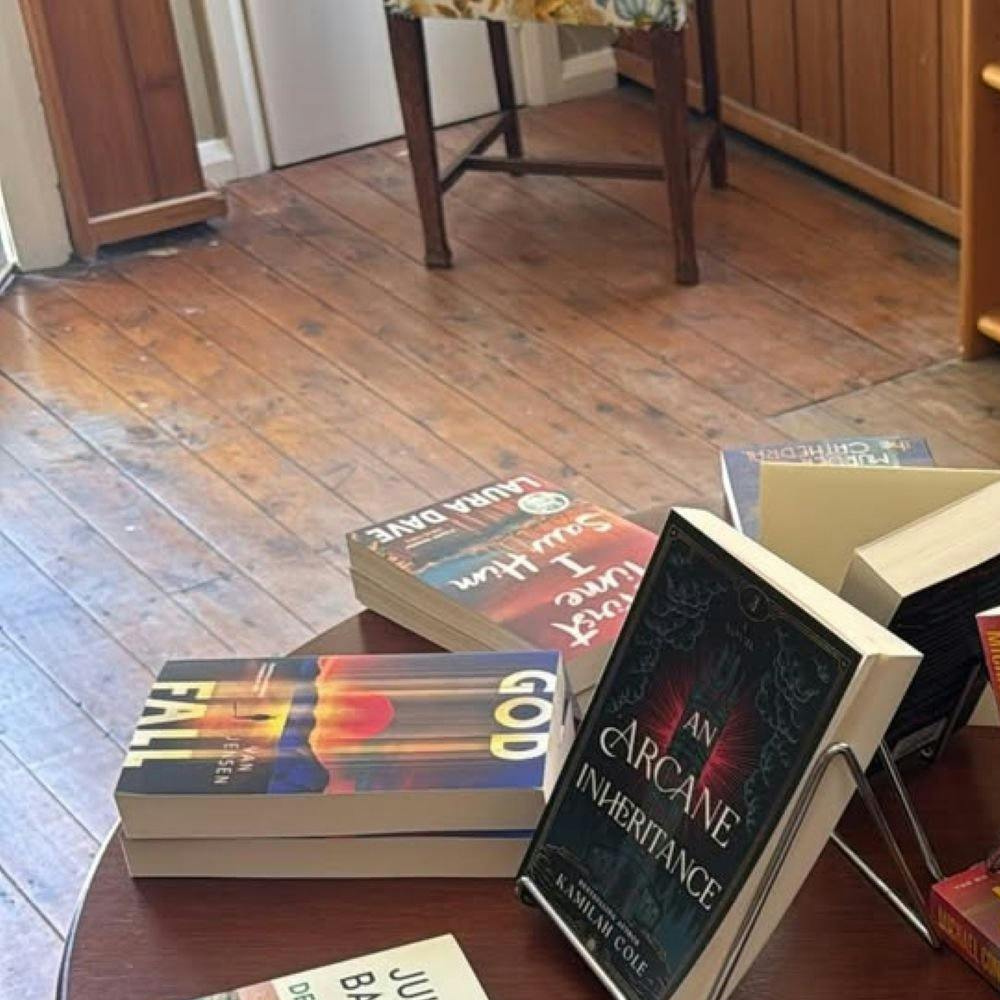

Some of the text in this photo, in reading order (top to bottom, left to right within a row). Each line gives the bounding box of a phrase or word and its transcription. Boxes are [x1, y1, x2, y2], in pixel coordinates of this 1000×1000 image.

[365, 508, 448, 543] DAVE
[445, 476, 545, 513] LAURA
[453, 512, 614, 590] Saw Him
[550, 552, 596, 578] I
[122, 680, 216, 769] FALL
[488, 669, 559, 761] GOD
[682, 710, 720, 749] AN
[599, 718, 742, 850] ARCANE
[576, 762, 724, 912] INHERITANCE
[556, 873, 649, 977] KAMILAH COLE
